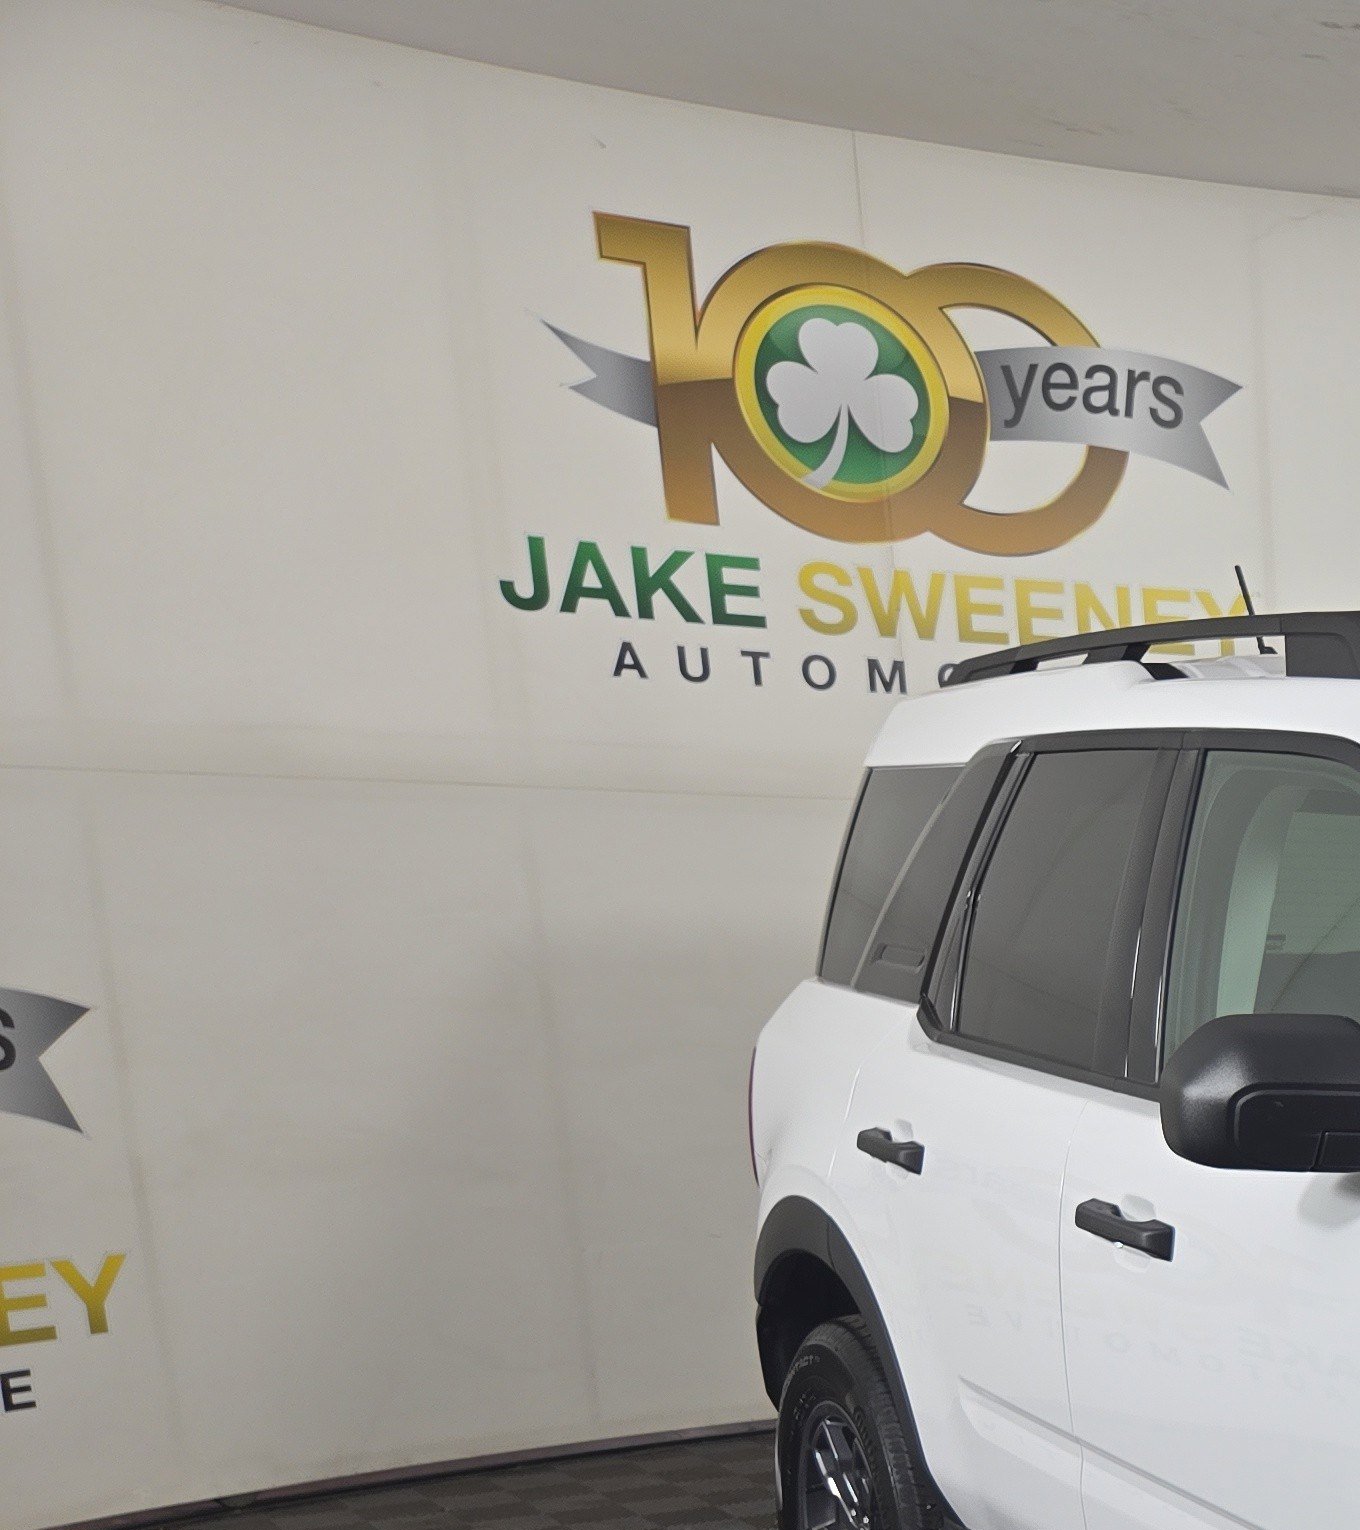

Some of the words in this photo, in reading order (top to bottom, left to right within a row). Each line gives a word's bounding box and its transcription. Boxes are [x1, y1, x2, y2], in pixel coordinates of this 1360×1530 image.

[592, 211, 1129, 558] 100
[1001, 358, 1185, 430] years
[498, 535, 768, 629] JAKE
[797, 562, 1252, 658] SWEENEY
